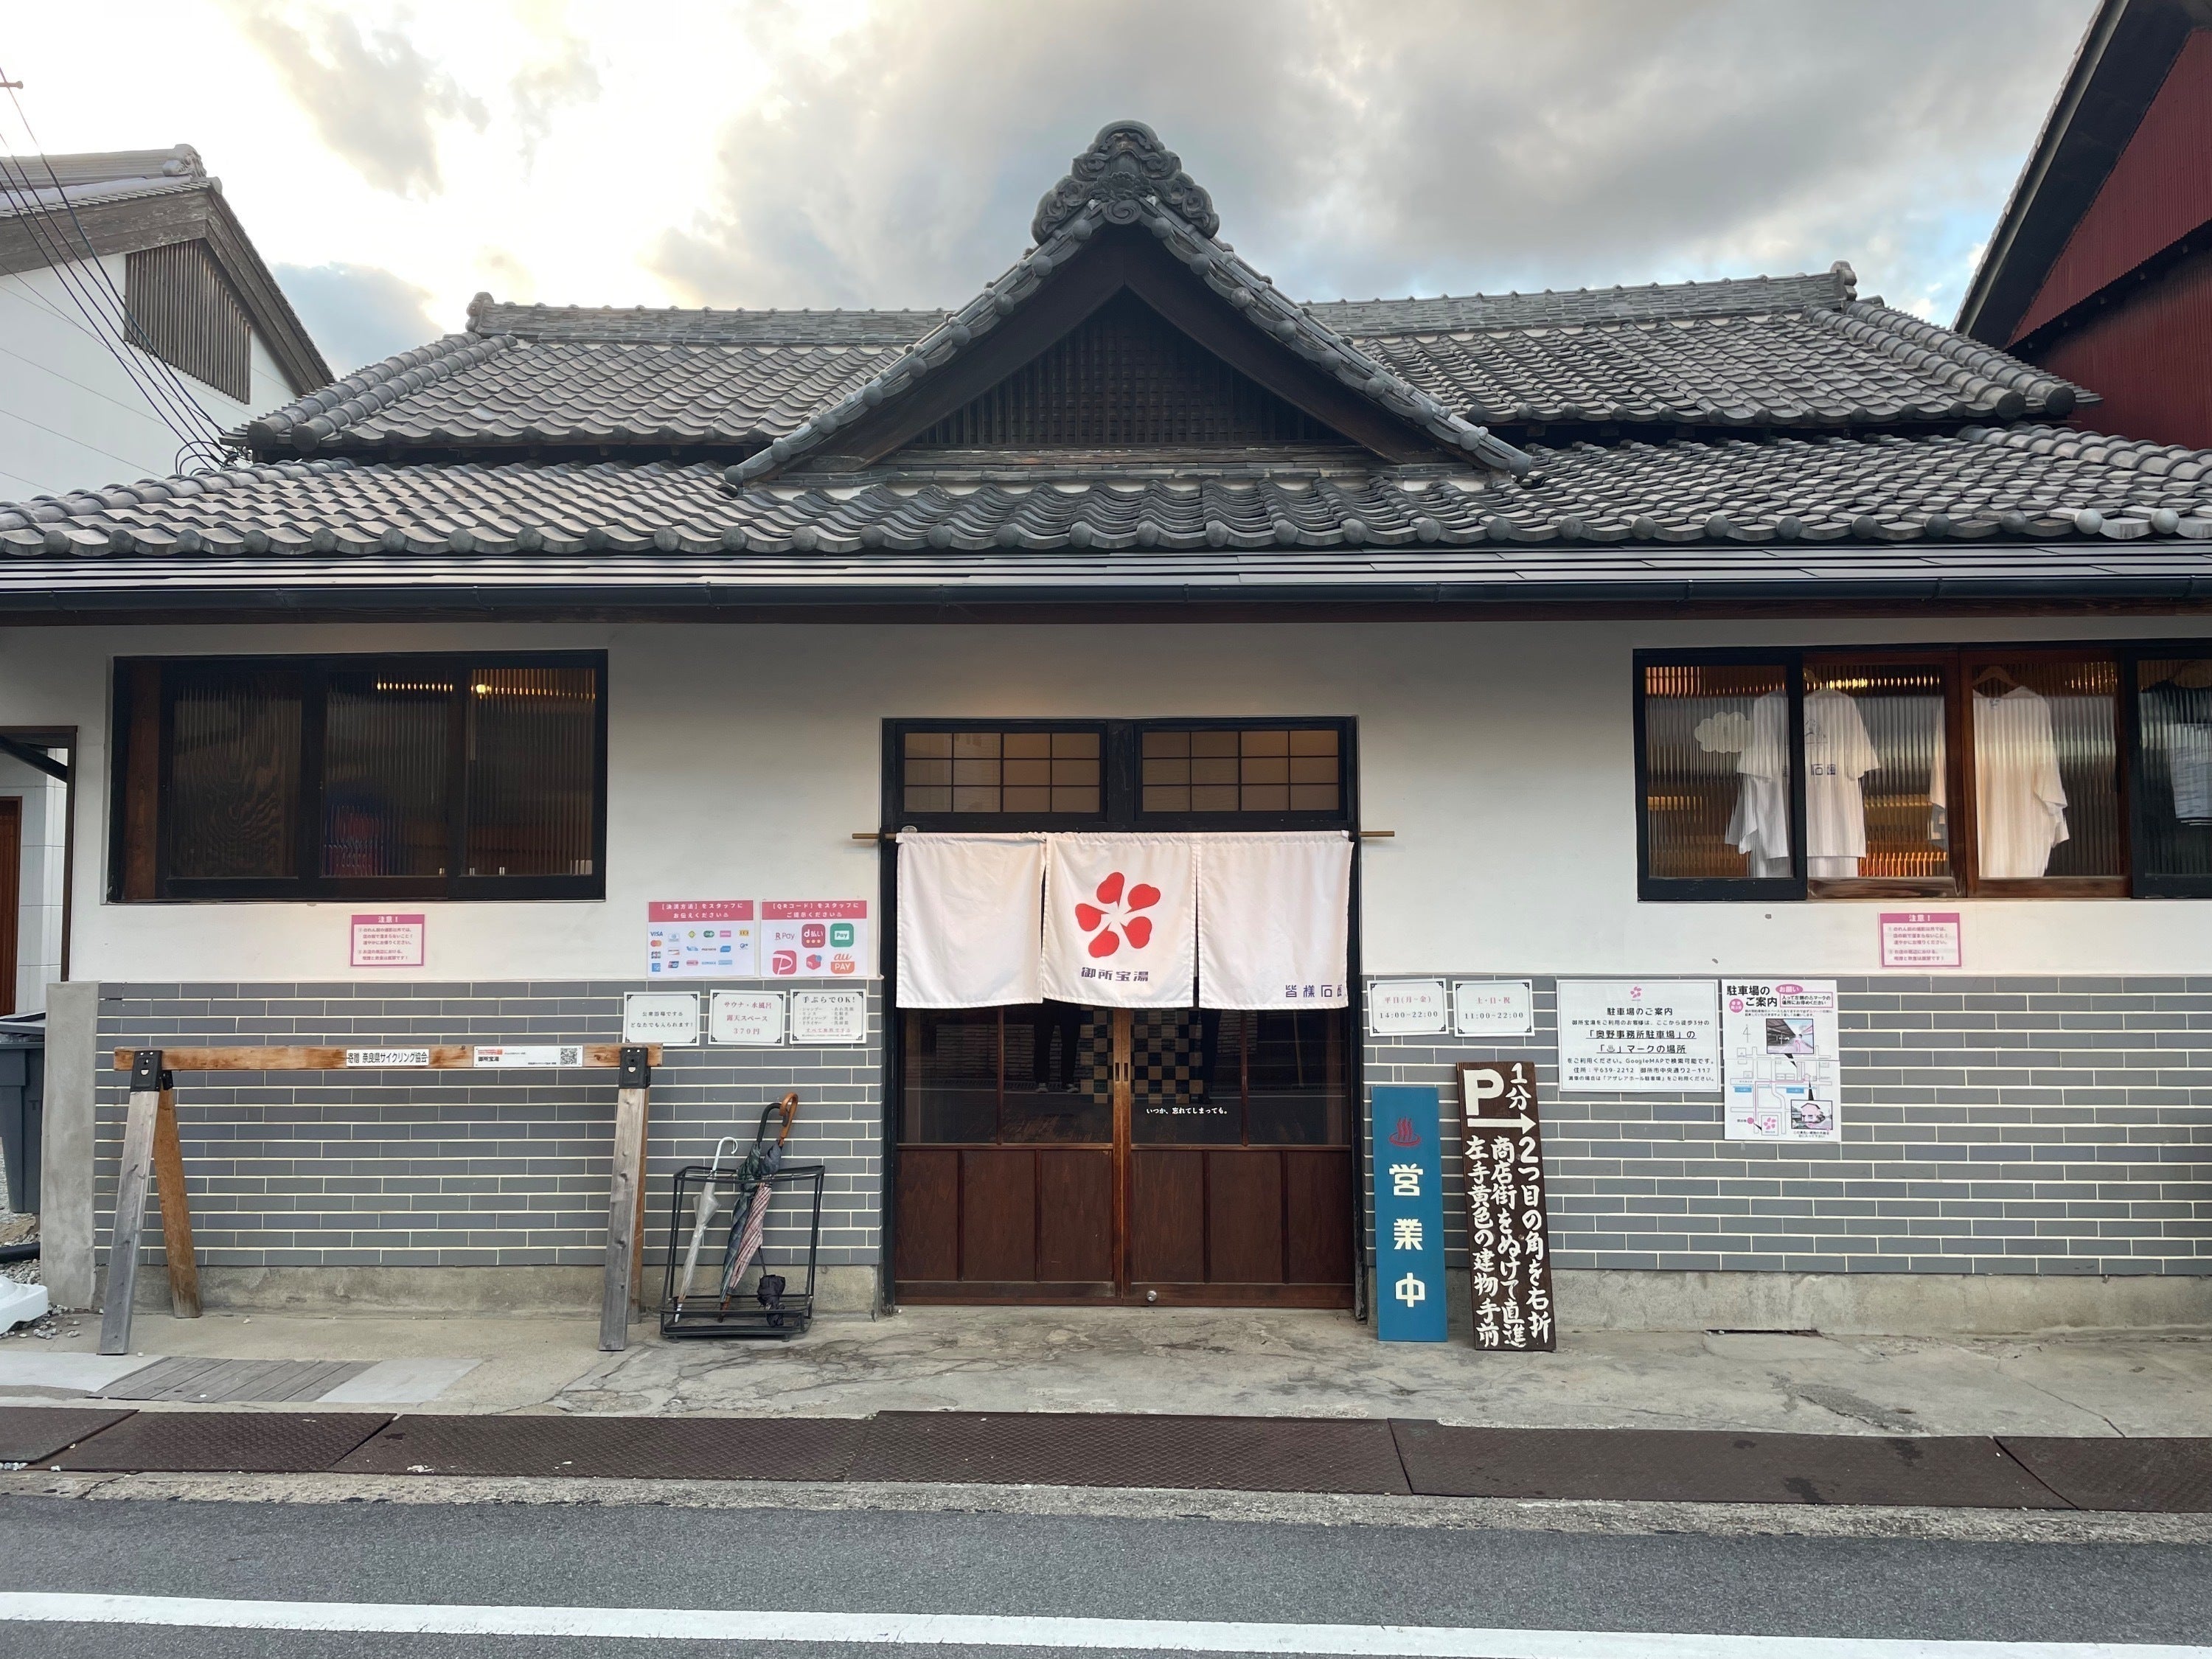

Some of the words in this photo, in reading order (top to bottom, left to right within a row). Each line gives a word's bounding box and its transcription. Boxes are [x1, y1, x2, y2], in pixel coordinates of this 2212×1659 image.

[782, 932, 796, 940] Pay
[804, 929, 824, 937] d払い
[835, 962, 852, 970] PAY
[1081, 967, 1149, 982] 御所宝湯
[1727, 985, 1770, 995] 駐車場の
[1745, 997, 1778, 1007] ご案内
[1607, 1007, 1673, 1016] 駐車場のご案内
[1590, 1030, 1696, 1039] 「奥野事務所駐車場」の
[347, 1052, 360, 1064] 寄贈
[362, 1051, 428, 1063] 奈良県サイクリング協会
[1464, 1069, 1504, 1116] P
[1506, 1062, 1531, 1110] 1分
[1389, 1164, 1425, 1308] 営業中
[1465, 1135, 1501, 1347] 左手黄色の建物手前
[1491, 1135, 1526, 1348] 商店街をぬけて直進
[1518, 1136, 1551, 1343] 2つ目の角を右折
